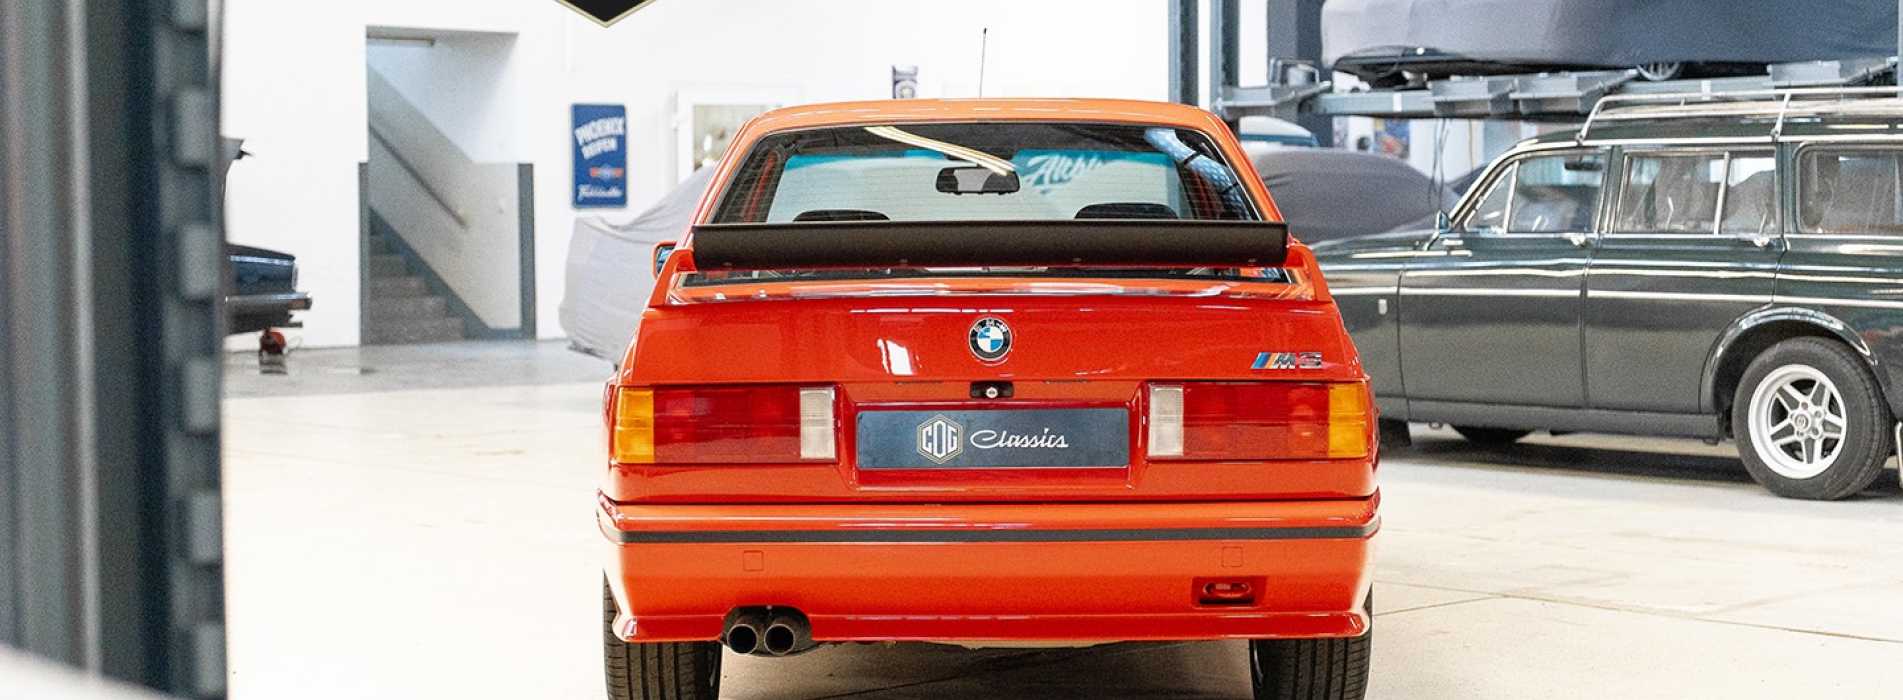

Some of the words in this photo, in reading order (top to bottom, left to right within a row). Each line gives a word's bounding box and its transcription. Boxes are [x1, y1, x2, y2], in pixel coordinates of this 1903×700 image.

[1271, 351, 1322, 369] M3
[921, 419, 959, 459] COG
[970, 427, 1069, 449] Classics
